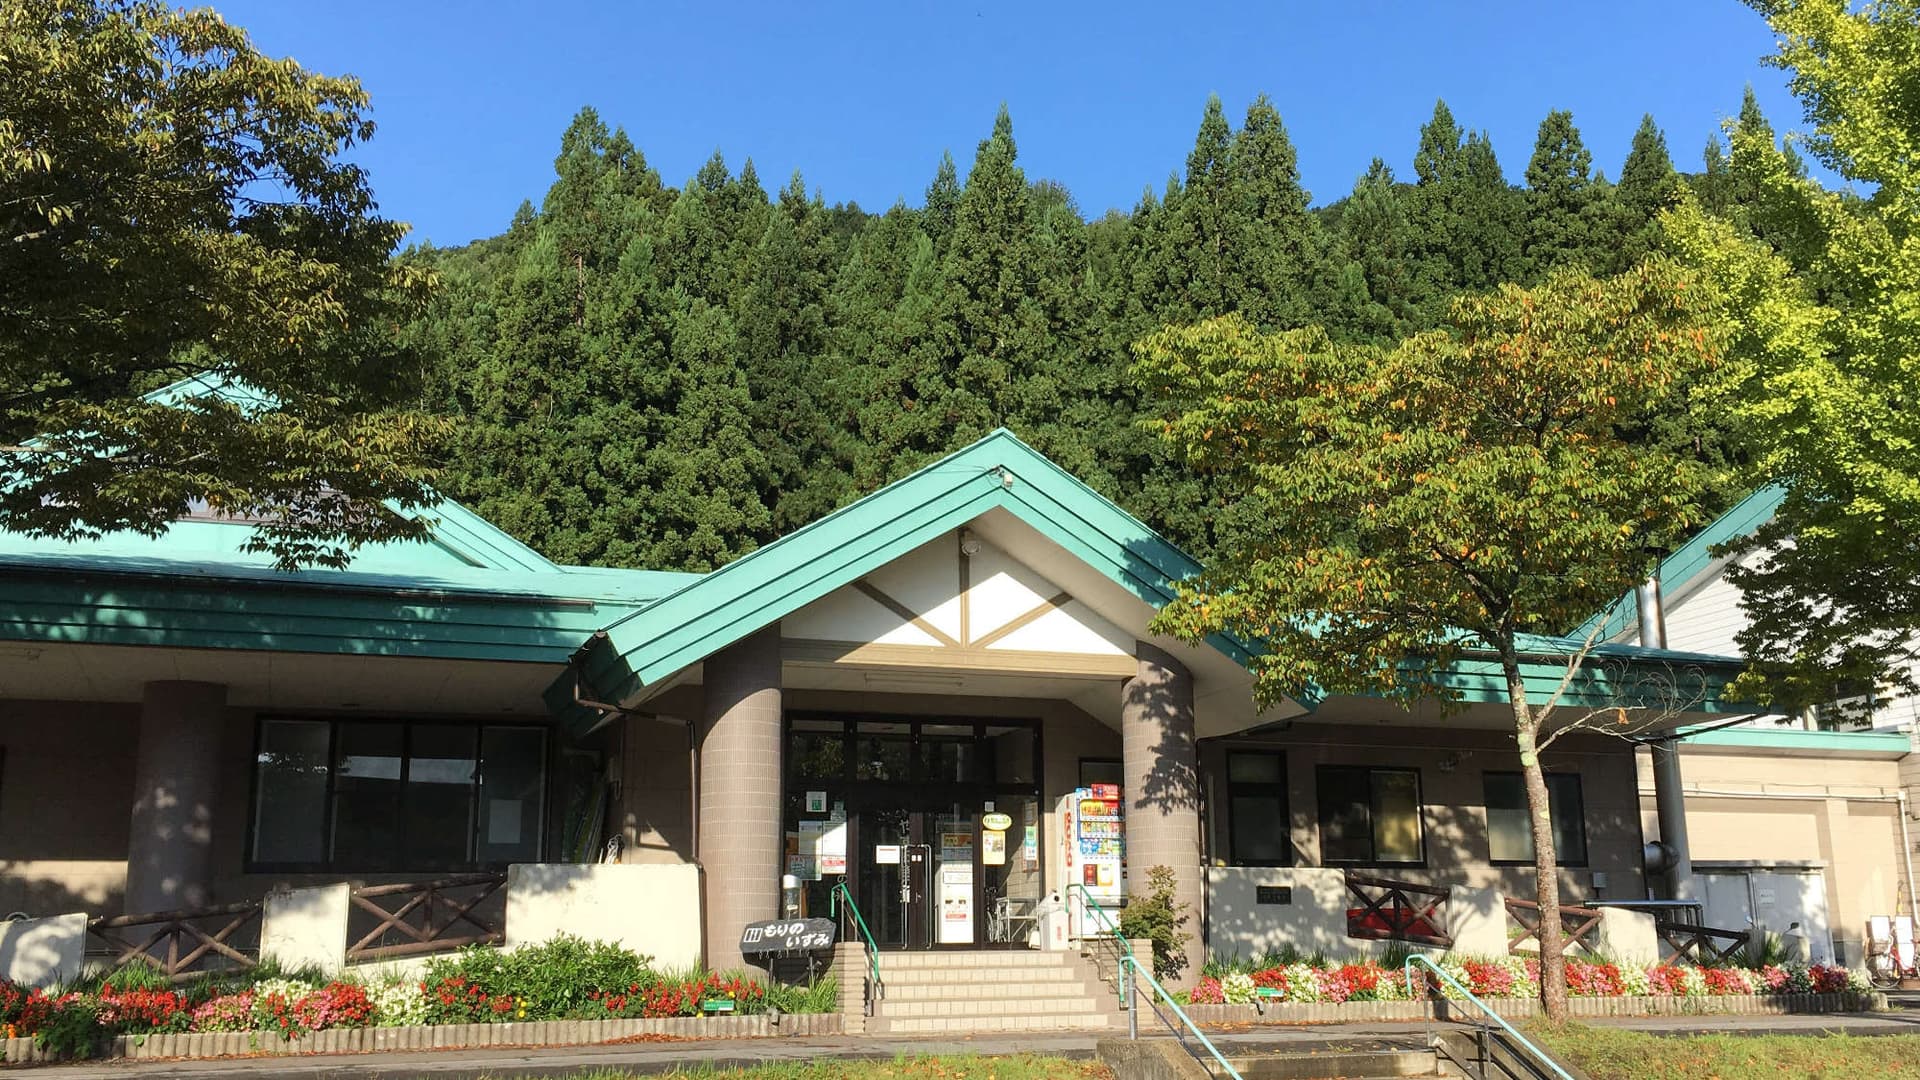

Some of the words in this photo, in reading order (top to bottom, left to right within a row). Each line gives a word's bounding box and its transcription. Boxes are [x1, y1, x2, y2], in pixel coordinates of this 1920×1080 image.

[764, 922, 805, 938] もりの
[786, 933, 830, 948] いずみ
